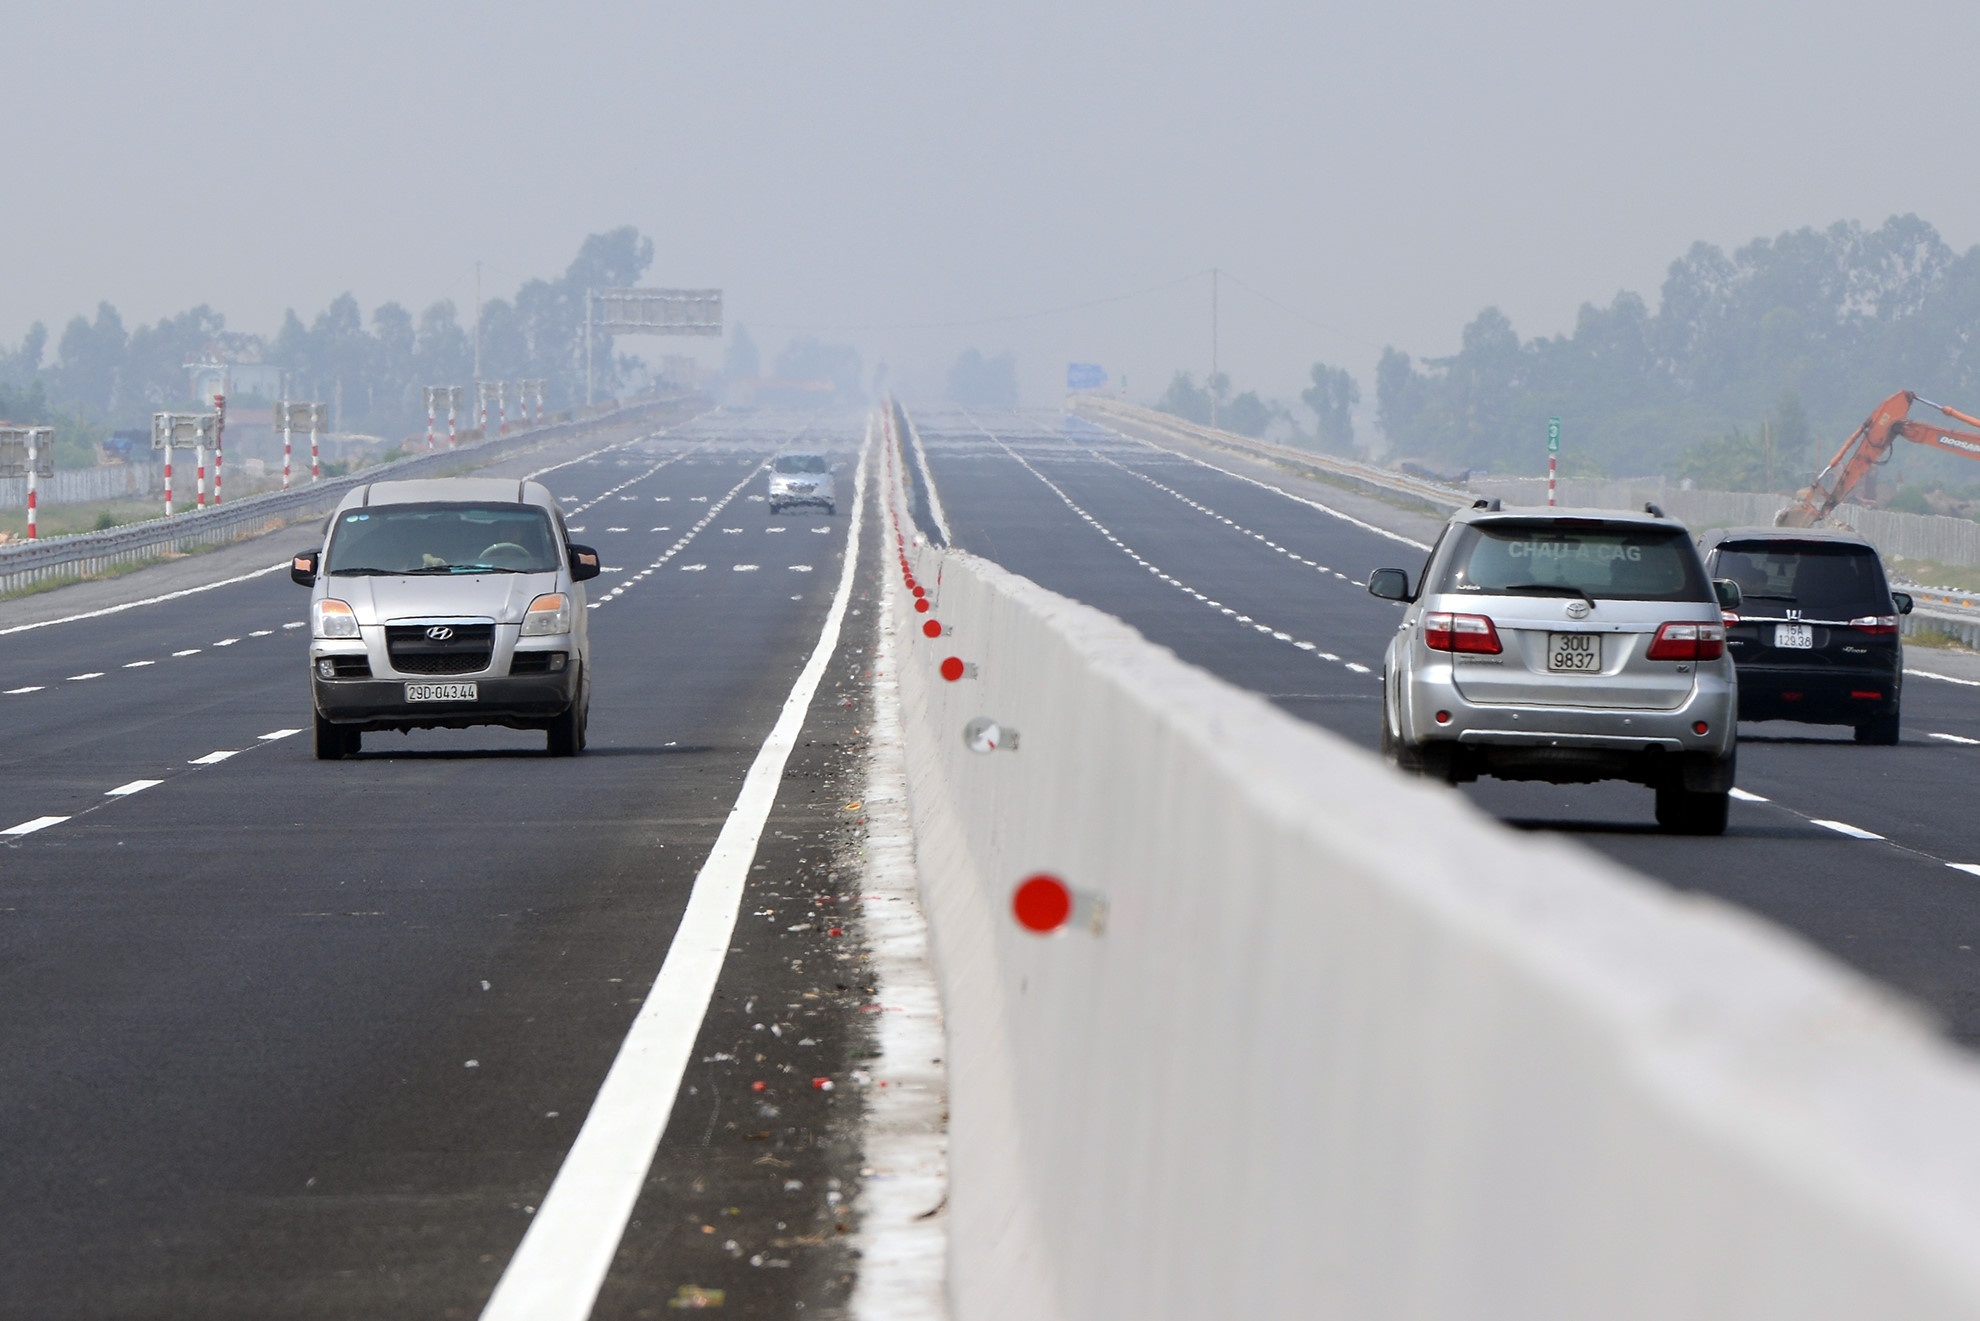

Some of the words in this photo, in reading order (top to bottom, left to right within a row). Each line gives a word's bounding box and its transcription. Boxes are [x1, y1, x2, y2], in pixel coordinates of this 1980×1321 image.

[1560, 635, 1590, 651] 30U
[1779, 635, 1812, 647] 129.38
[1554, 652, 1594, 668] 9837
[408, 685, 475, 700] 29D-043.44
